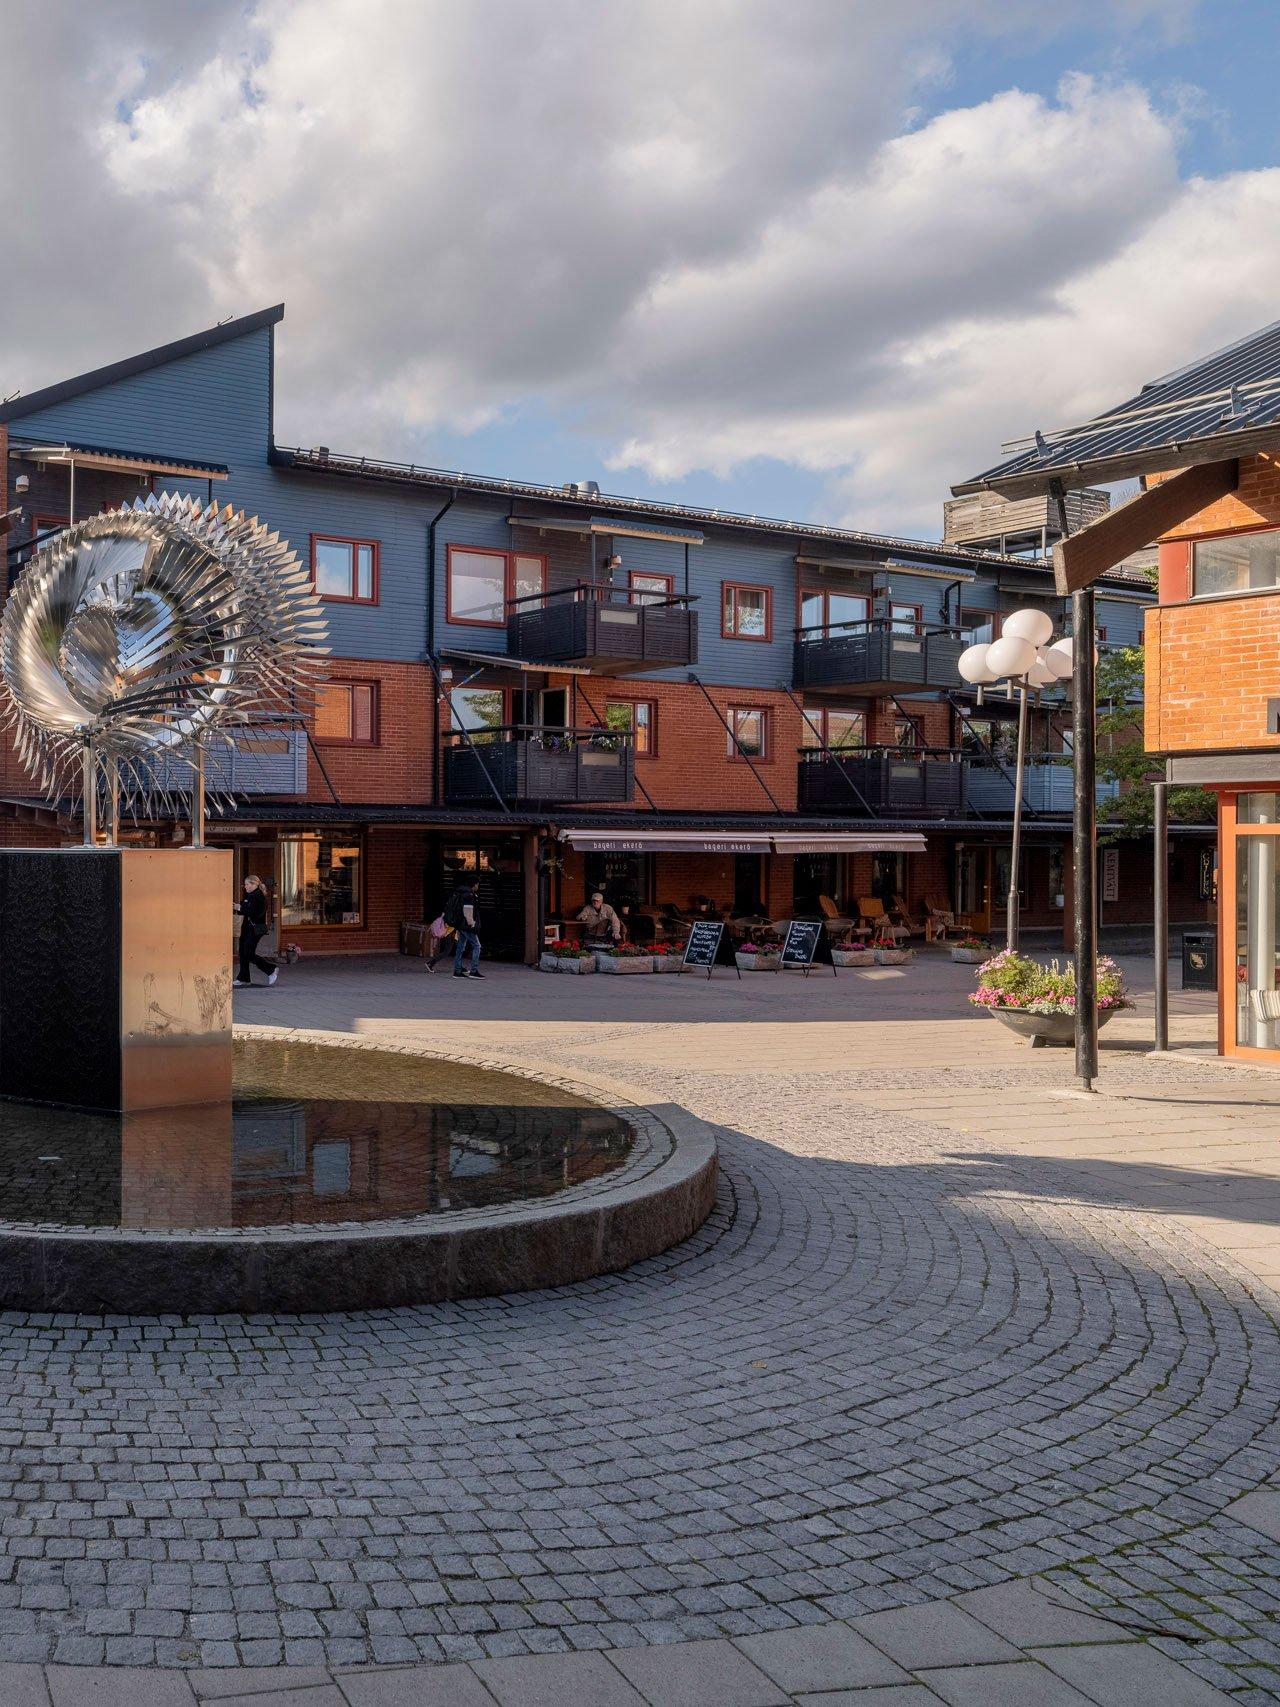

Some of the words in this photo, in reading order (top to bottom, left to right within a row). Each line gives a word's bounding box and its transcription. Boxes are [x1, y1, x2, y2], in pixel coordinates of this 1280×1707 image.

[593, 842, 616, 850] bageri
[622, 841, 643, 849] ekerö
[703, 842, 727, 851] bageri
[1106, 852, 1116, 898] KEMTVÄTT
